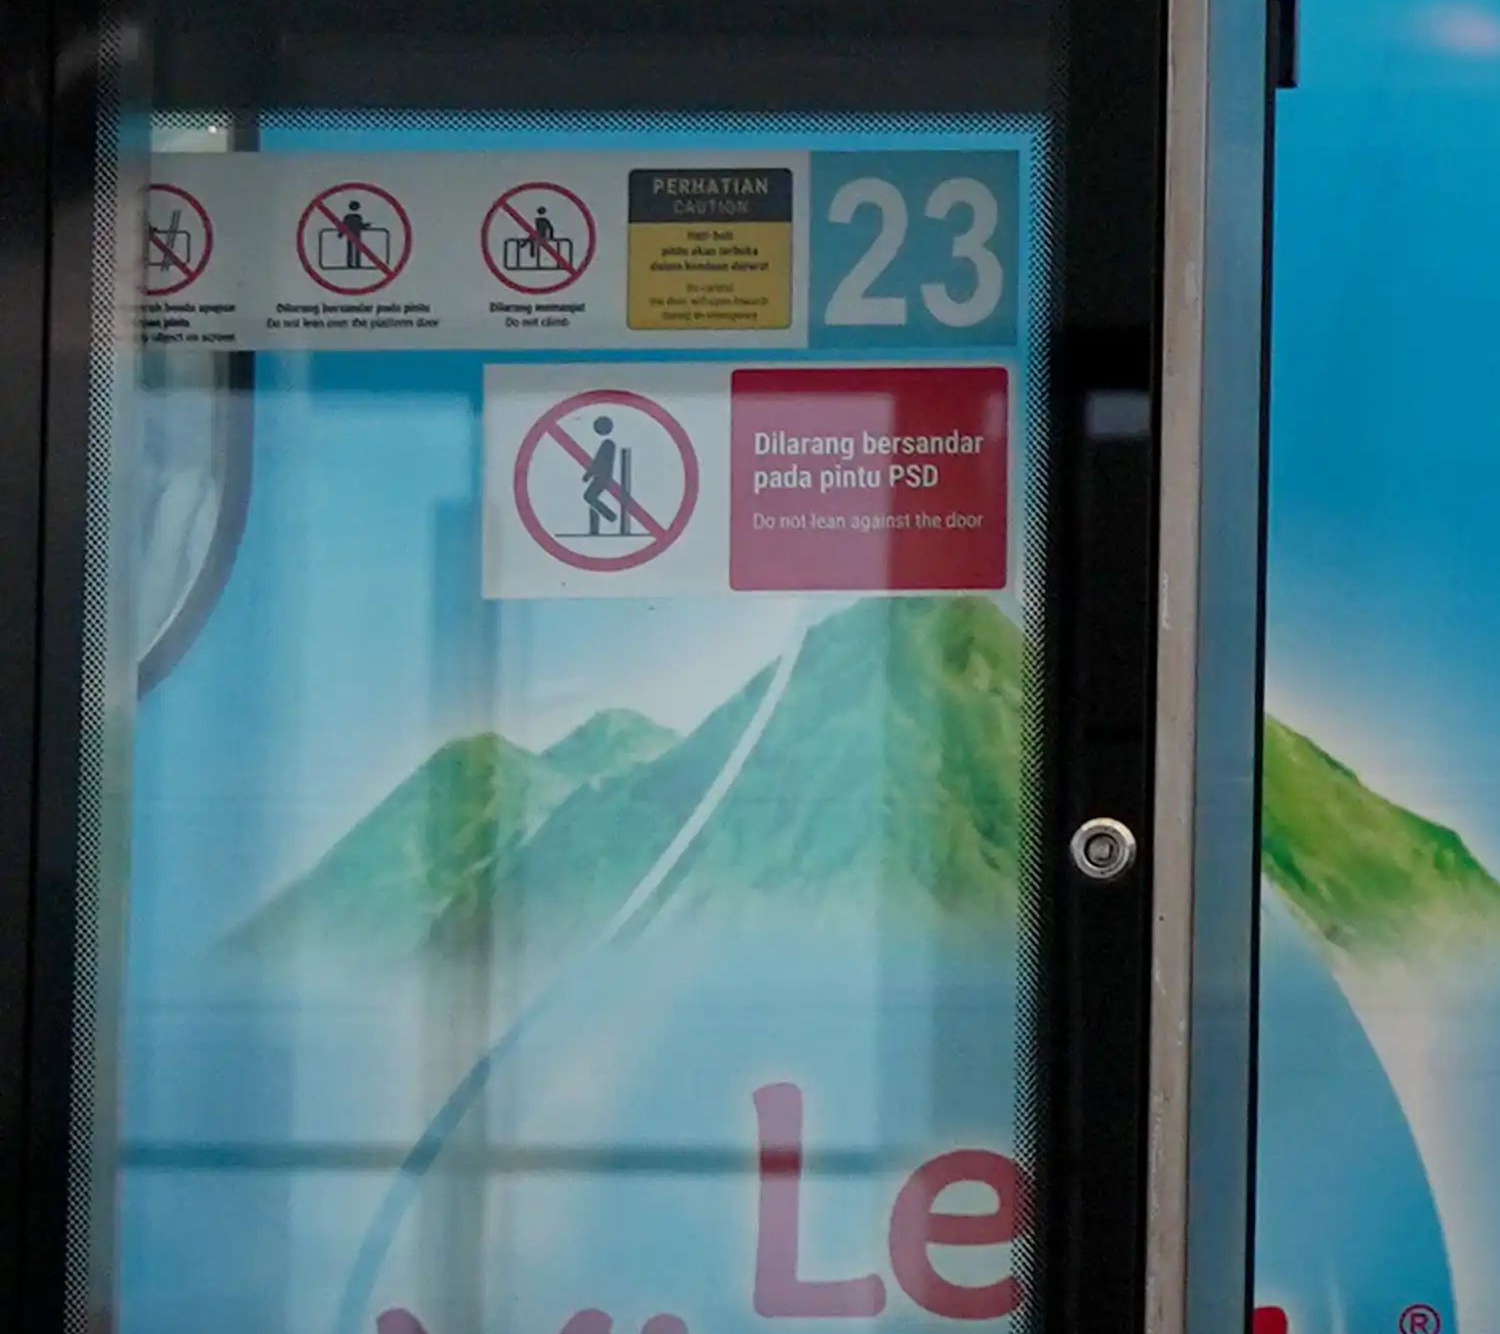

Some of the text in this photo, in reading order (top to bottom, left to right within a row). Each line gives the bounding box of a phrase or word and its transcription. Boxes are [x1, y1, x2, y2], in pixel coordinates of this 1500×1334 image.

[652, 176, 769, 196] PERHATIAN
[673, 198, 749, 216] CAUTION
[824, 176, 1004, 328] 23
[753, 429, 985, 460] Dilarang bersandar
[753, 464, 939, 494] pada pintu PSD
[753, 512, 984, 534] Do not lean against the door
[752, 1081, 1034, 1321] Le
